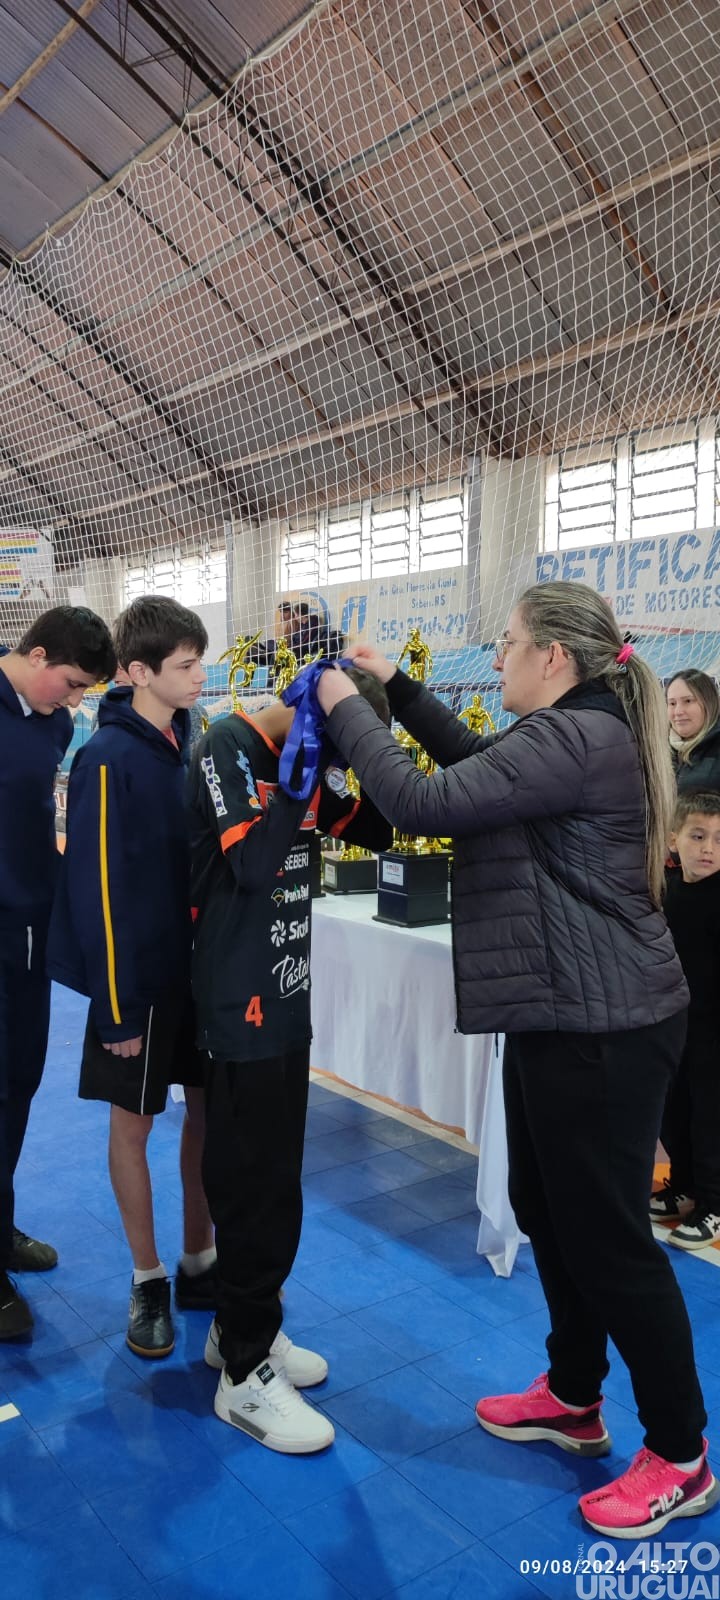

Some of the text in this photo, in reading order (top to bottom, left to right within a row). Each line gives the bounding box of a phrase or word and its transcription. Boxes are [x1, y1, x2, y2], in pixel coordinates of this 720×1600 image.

[616, 593, 634, 616] DE
[284, 851, 309, 871] SEBERI
[244, 995, 264, 1028] 4
[650, 1484, 684, 1519] FILA
